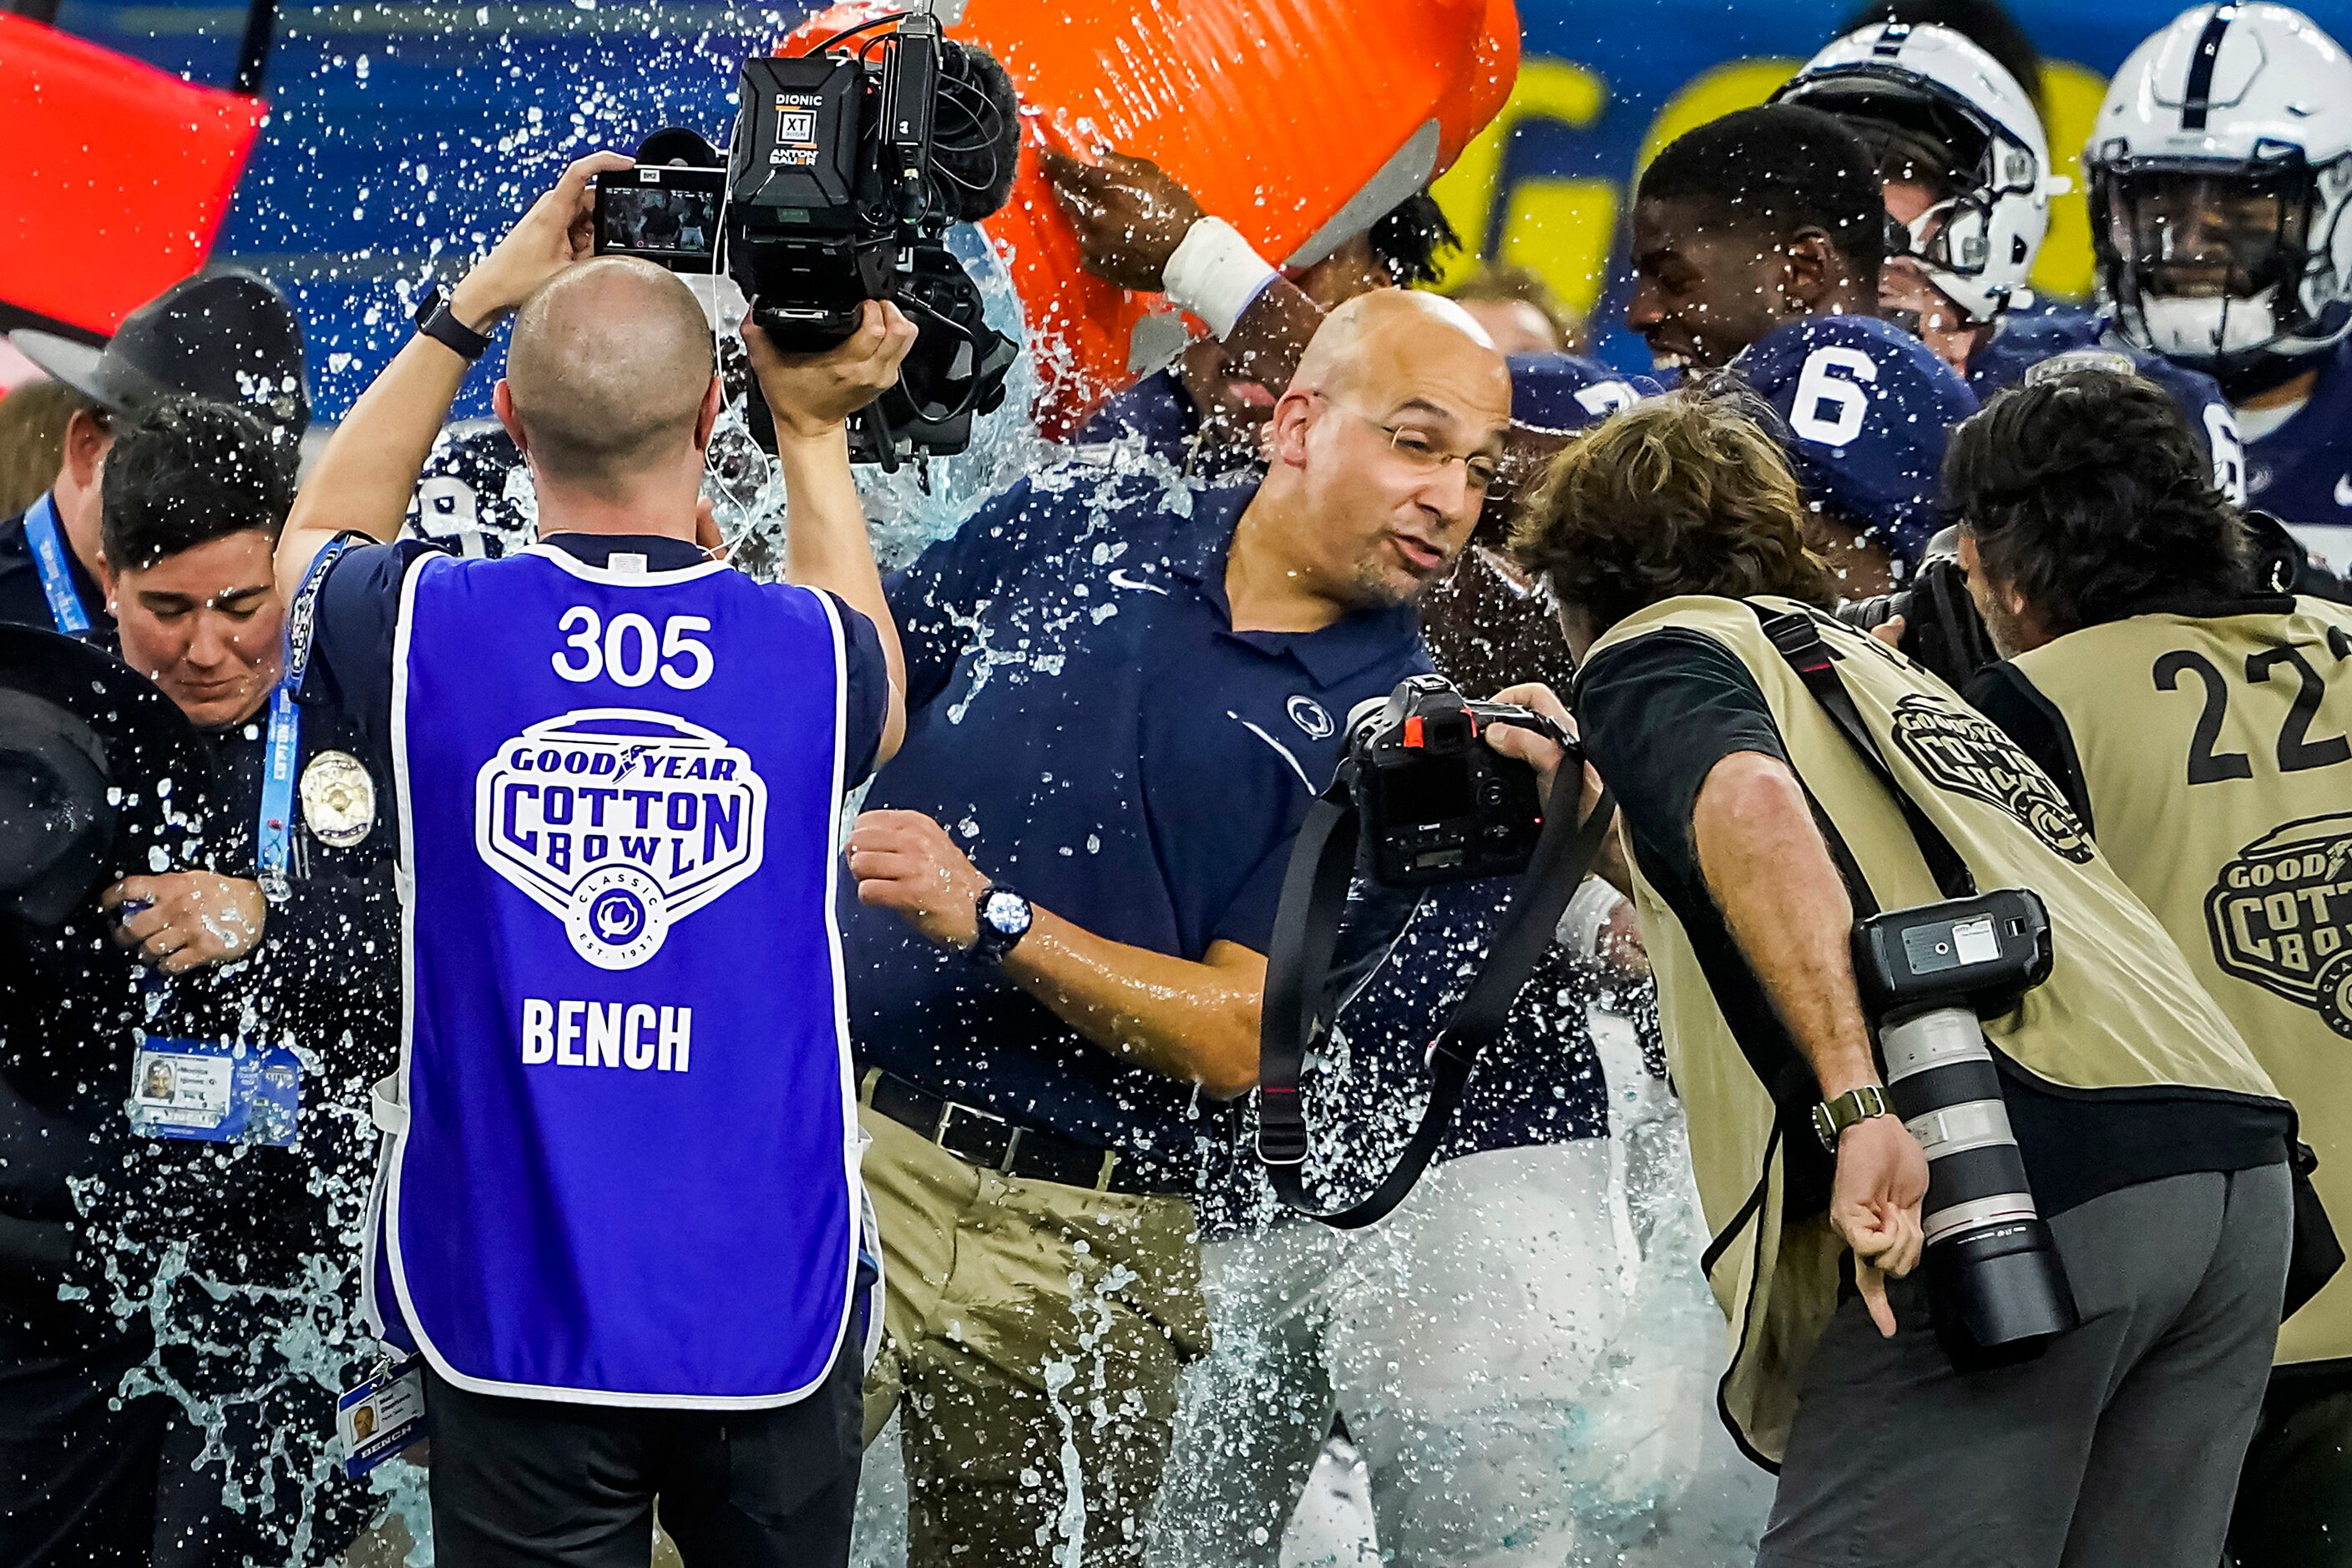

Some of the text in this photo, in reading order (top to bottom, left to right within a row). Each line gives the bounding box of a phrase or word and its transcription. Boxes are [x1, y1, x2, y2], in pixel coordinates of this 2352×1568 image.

[776, 94, 822, 106] DIONIC
[787, 118, 807, 131] XT
[771, 149, 819, 159] ANTON
[1789, 345, 1878, 447] 6
[552, 605, 714, 690] 305
[2152, 625, 2352, 785] 22
[503, 783, 741, 865] COTTON
[547, 832, 695, 880] BOWL
[579, 873, 658, 906] CLASSIC
[621, 934, 653, 959] 1937
[2277, 924, 2352, 972] BO
[522, 999, 692, 1072] BENCH
[361, 1424, 412, 1459] BENCH
